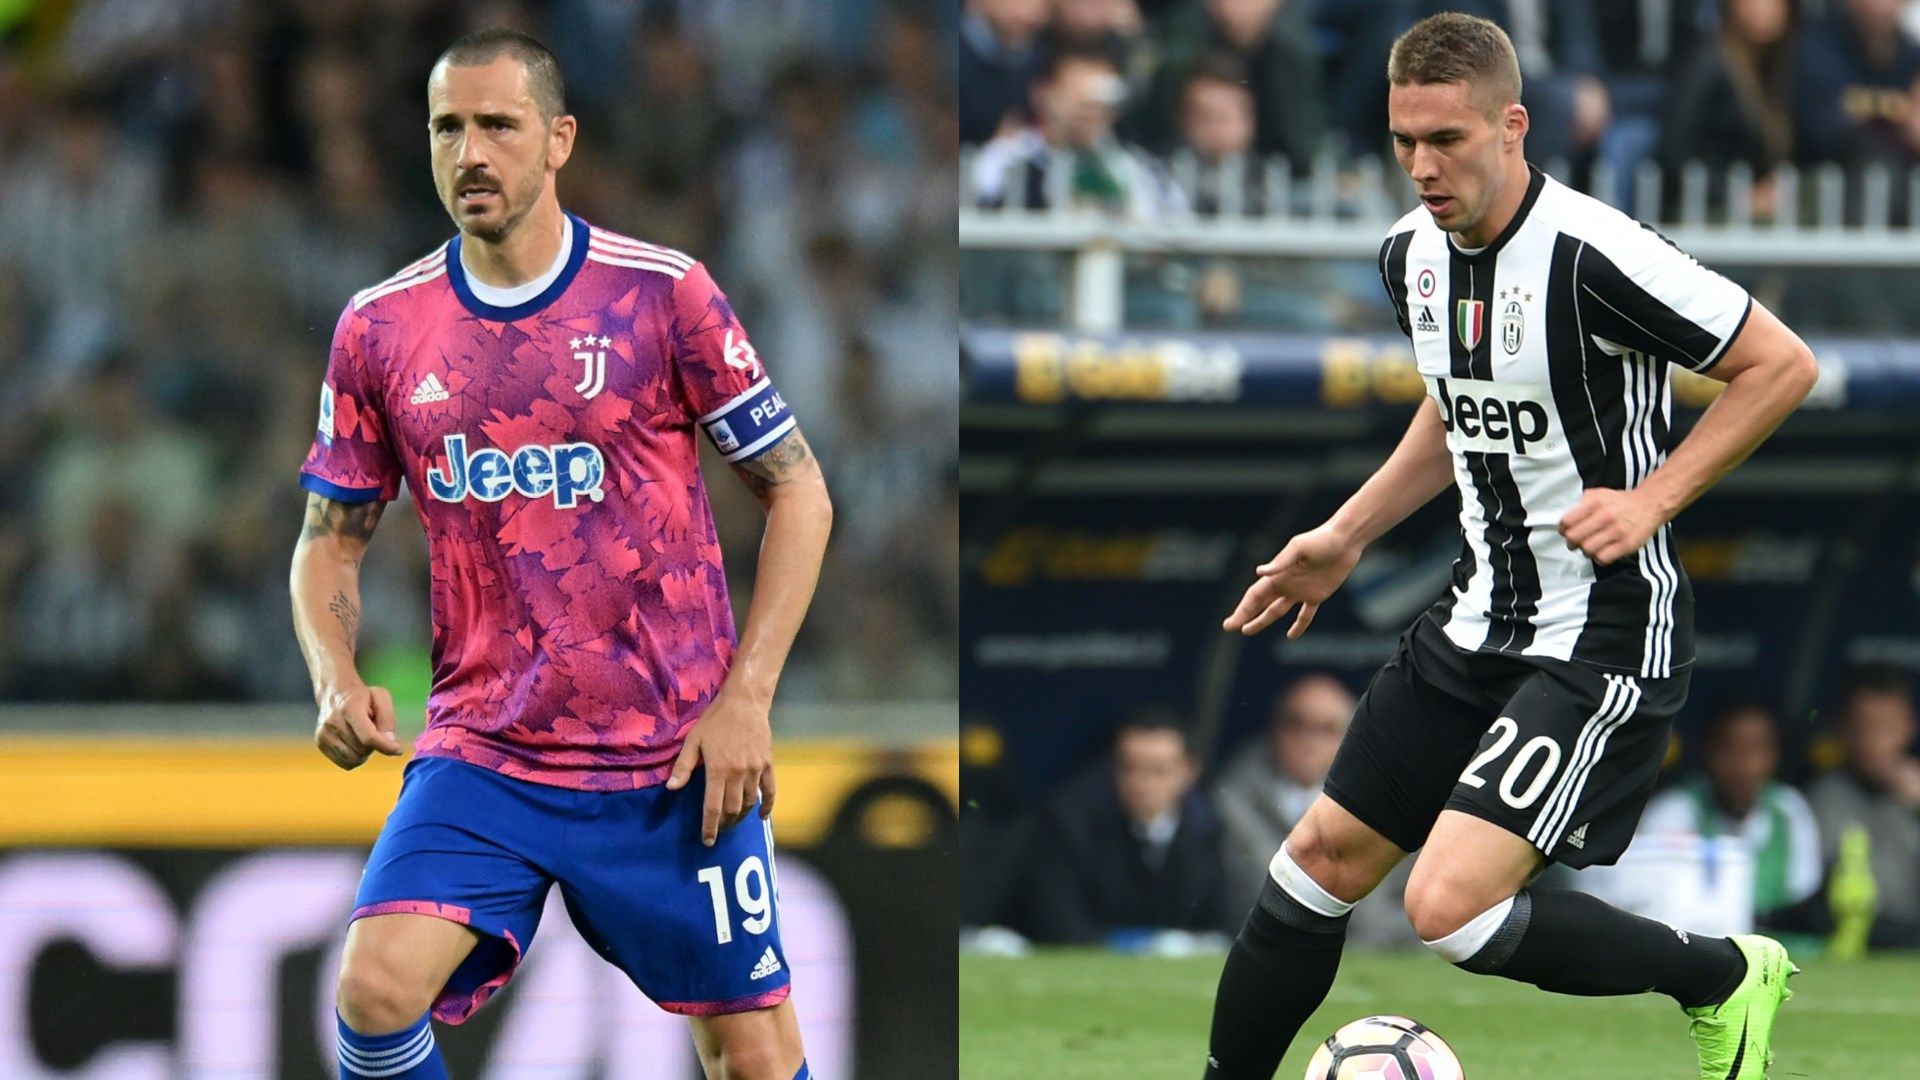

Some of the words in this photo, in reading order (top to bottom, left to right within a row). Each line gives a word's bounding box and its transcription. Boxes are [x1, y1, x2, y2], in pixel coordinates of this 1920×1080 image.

[1417, 323, 1440, 332] adidas
[411, 391, 449, 404] adidas
[427, 434, 605, 509] Jeep
[1458, 716, 1562, 810] 20
[698, 856, 771, 944] 19
[750, 961, 781, 980] adidas
